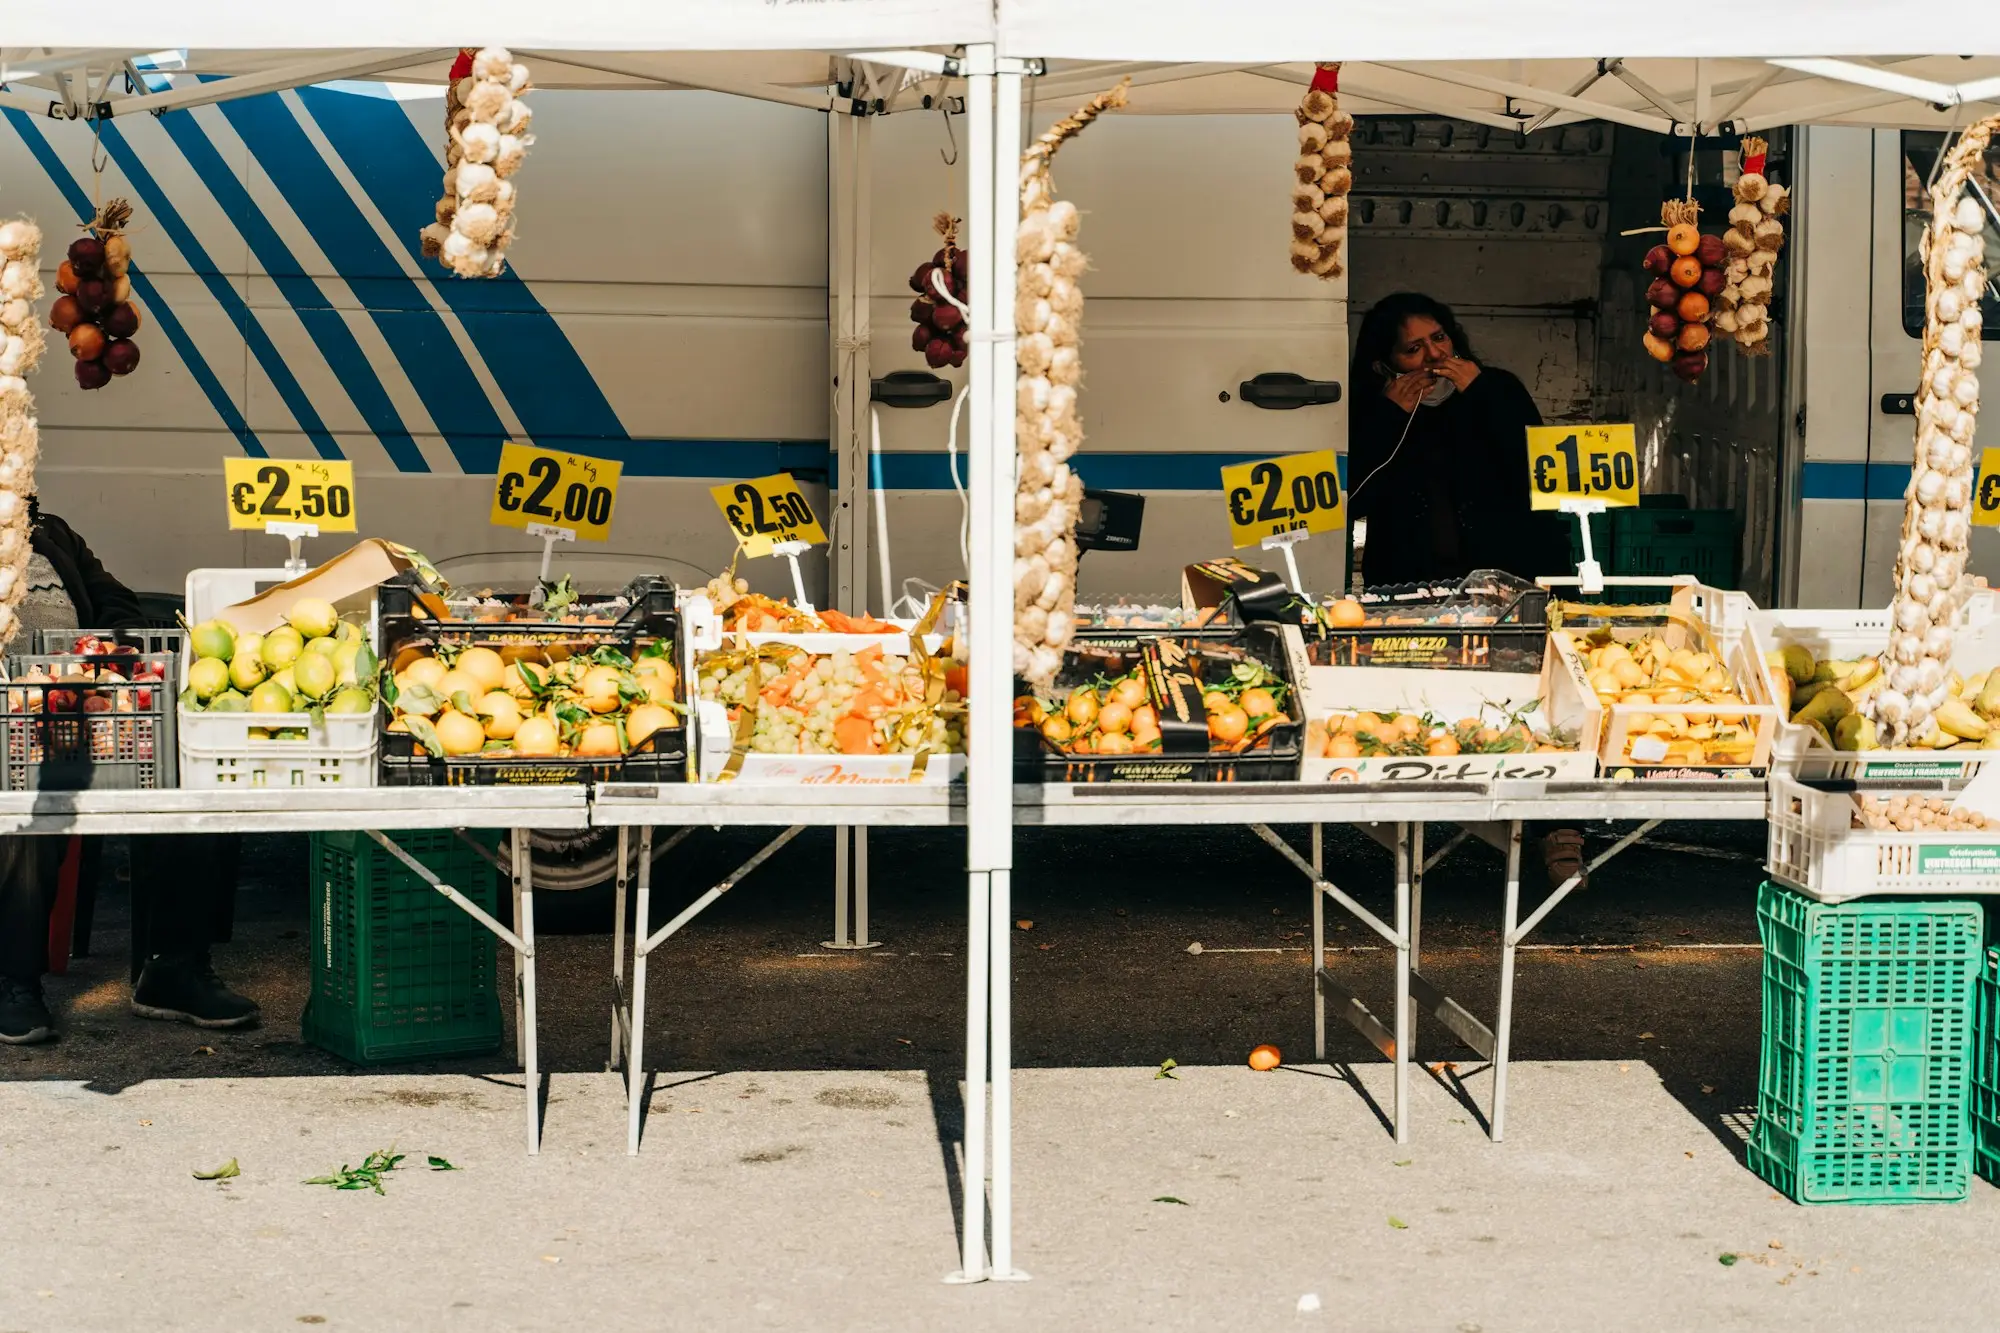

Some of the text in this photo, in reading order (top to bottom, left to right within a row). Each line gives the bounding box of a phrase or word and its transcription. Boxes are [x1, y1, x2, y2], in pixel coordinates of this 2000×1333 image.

[1599, 430, 1609, 444] Kg
[312, 464, 329, 481] Kg
[499, 457, 612, 525] €2,00
[567, 457, 597, 482] AL Kg
[1534, 435, 1634, 495] €1,50
[231, 466, 350, 519] €2,50
[726, 484, 814, 537] €2,50
[1229, 462, 1339, 526] €2,00
[1372, 637, 1448, 650] PANNOZZO
